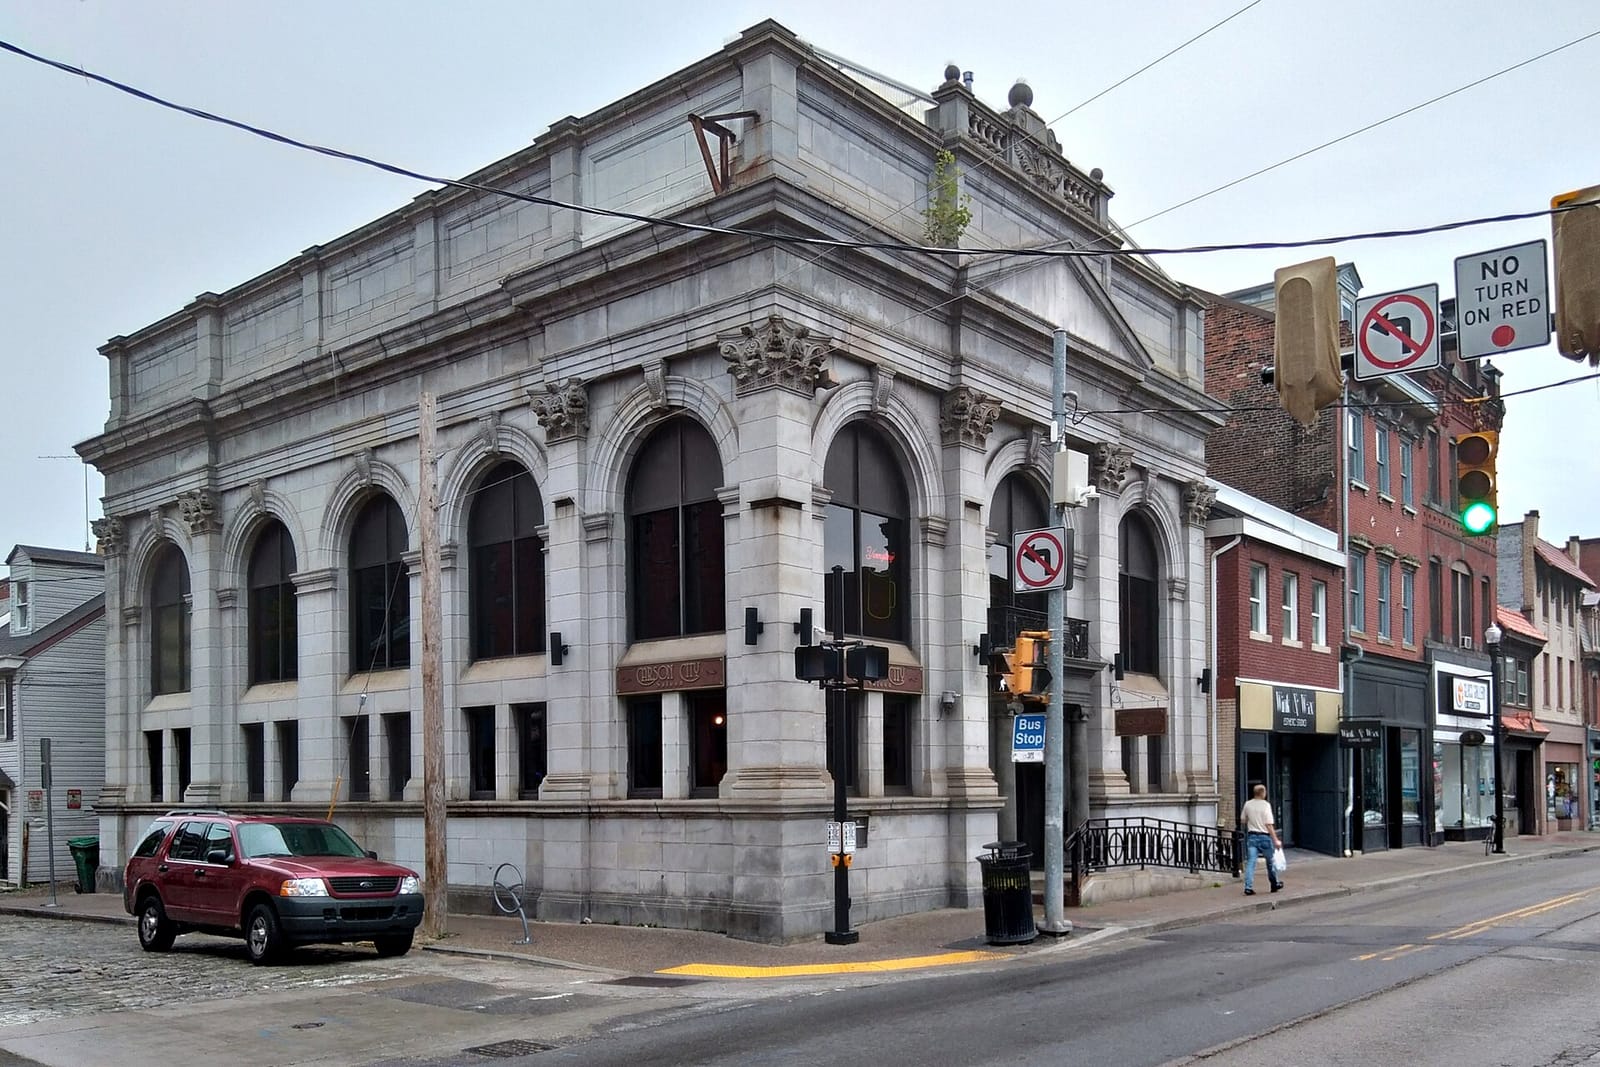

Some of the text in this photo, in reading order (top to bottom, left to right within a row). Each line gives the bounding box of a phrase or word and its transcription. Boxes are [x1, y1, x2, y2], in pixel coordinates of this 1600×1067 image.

[1481, 256, 1519, 280] NO
[1475, 278, 1528, 302] TURN
[1465, 298, 1540, 325] ON RED
[680, 661, 700, 682] CITY
[1019, 719, 1041, 730] Bus
[1015, 732, 1043, 746] Stop
